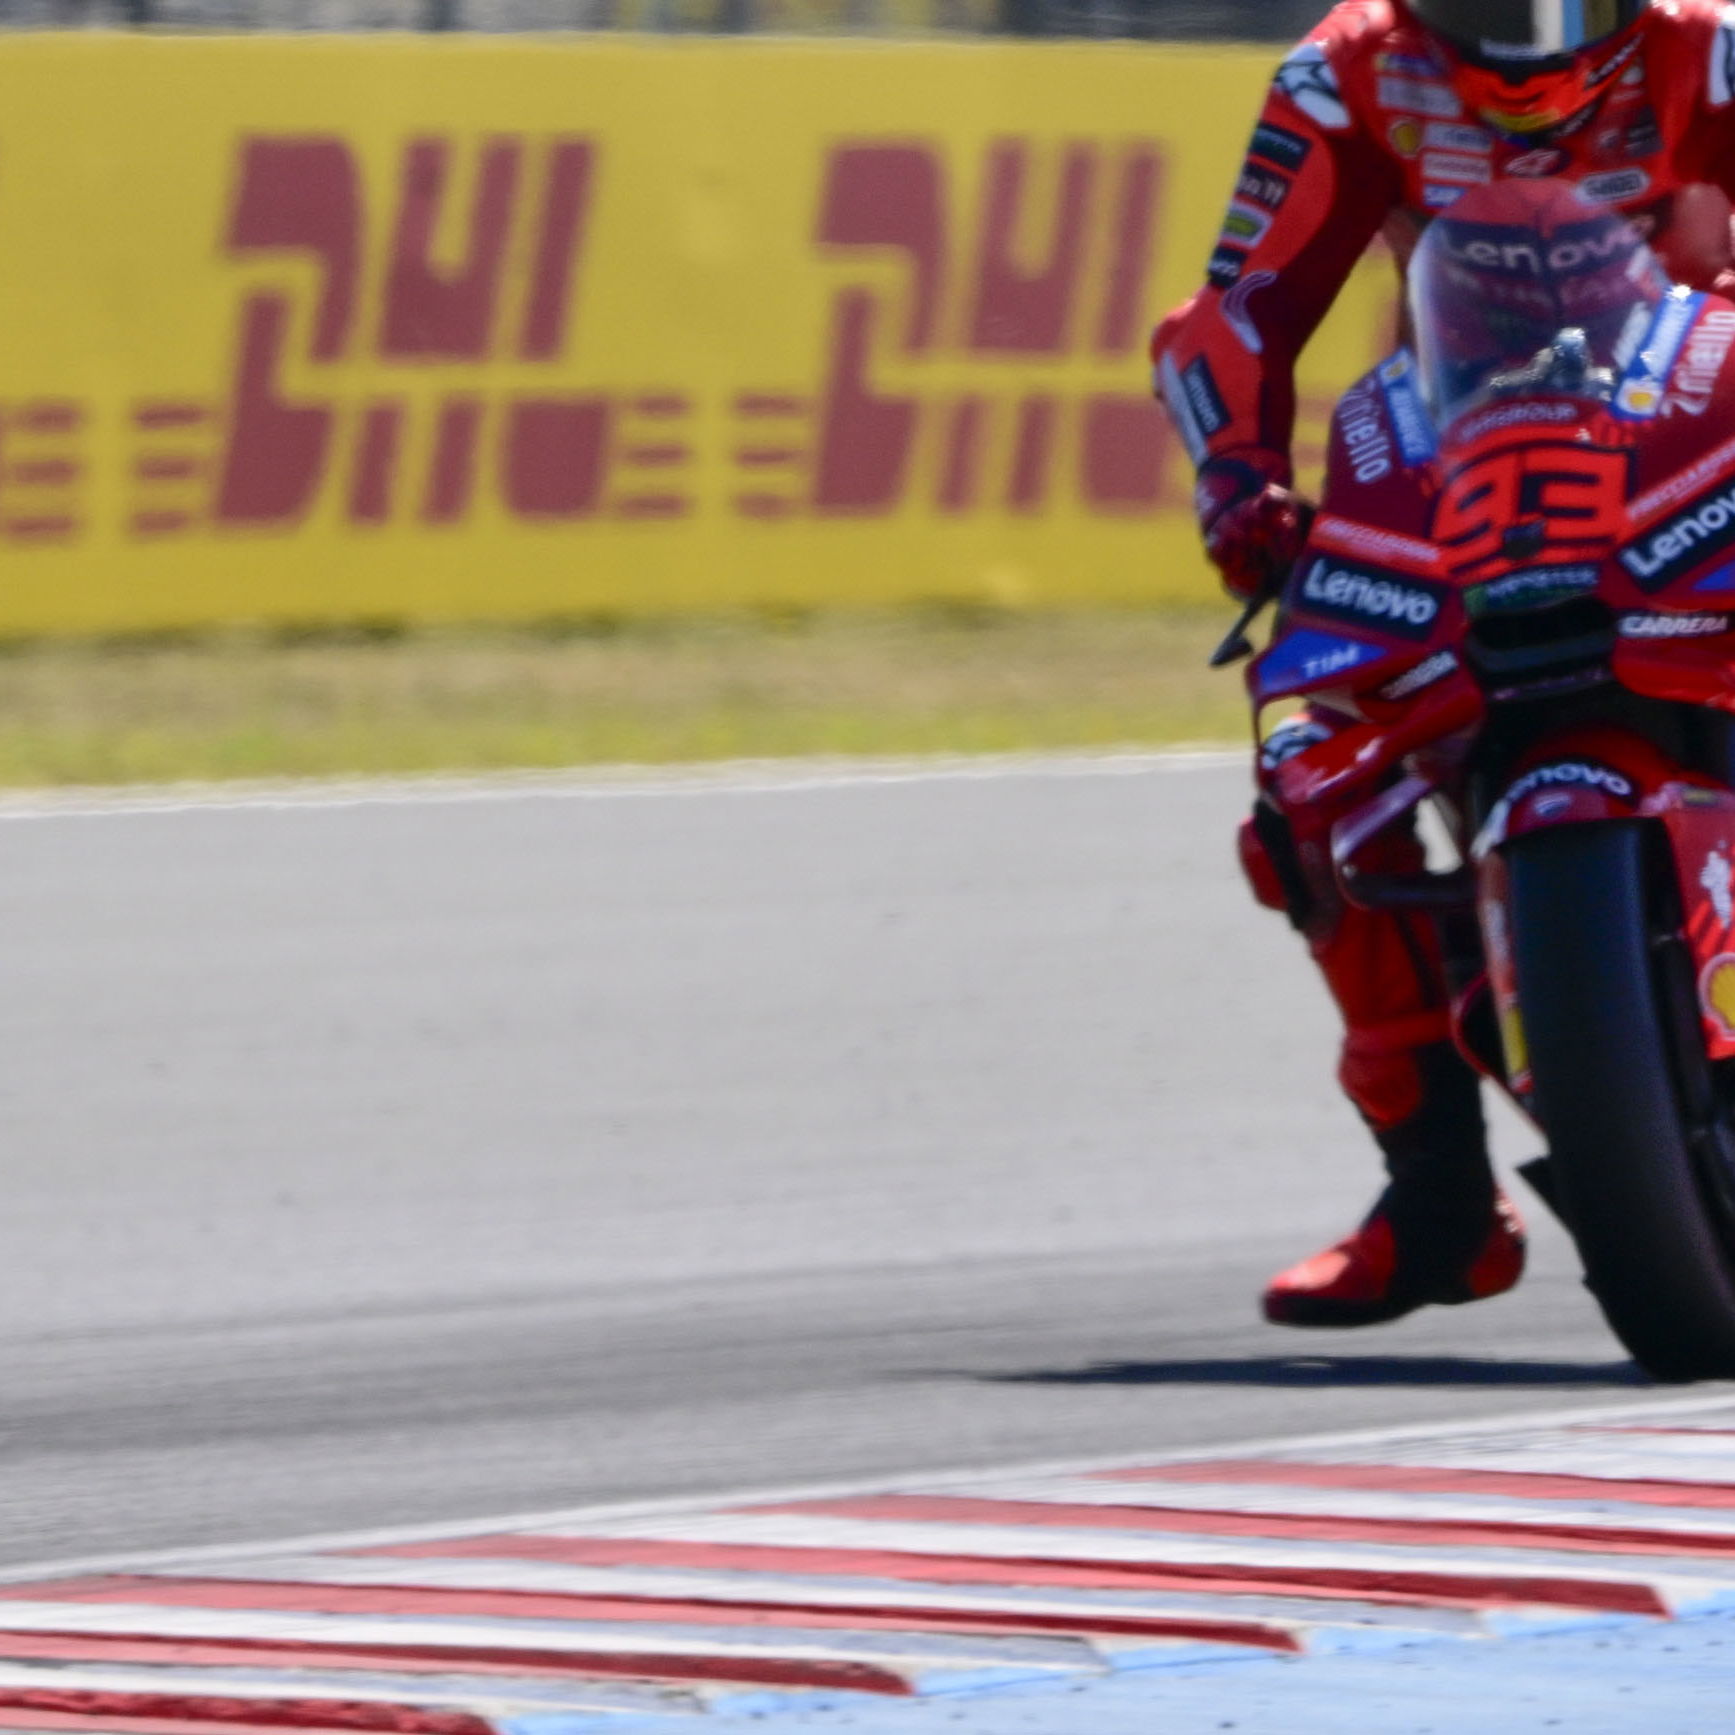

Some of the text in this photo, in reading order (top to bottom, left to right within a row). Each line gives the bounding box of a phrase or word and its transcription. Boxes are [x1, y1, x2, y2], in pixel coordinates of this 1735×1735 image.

[214, 133, 616, 527] DHL
[808, 137, 1186, 517] DHL
[1431, 446, 1630, 582] 93
[1303, 557, 1438, 625] Lenovo
[1619, 615, 1729, 639] CARRERA
[1303, 642, 1361, 679] TIM
